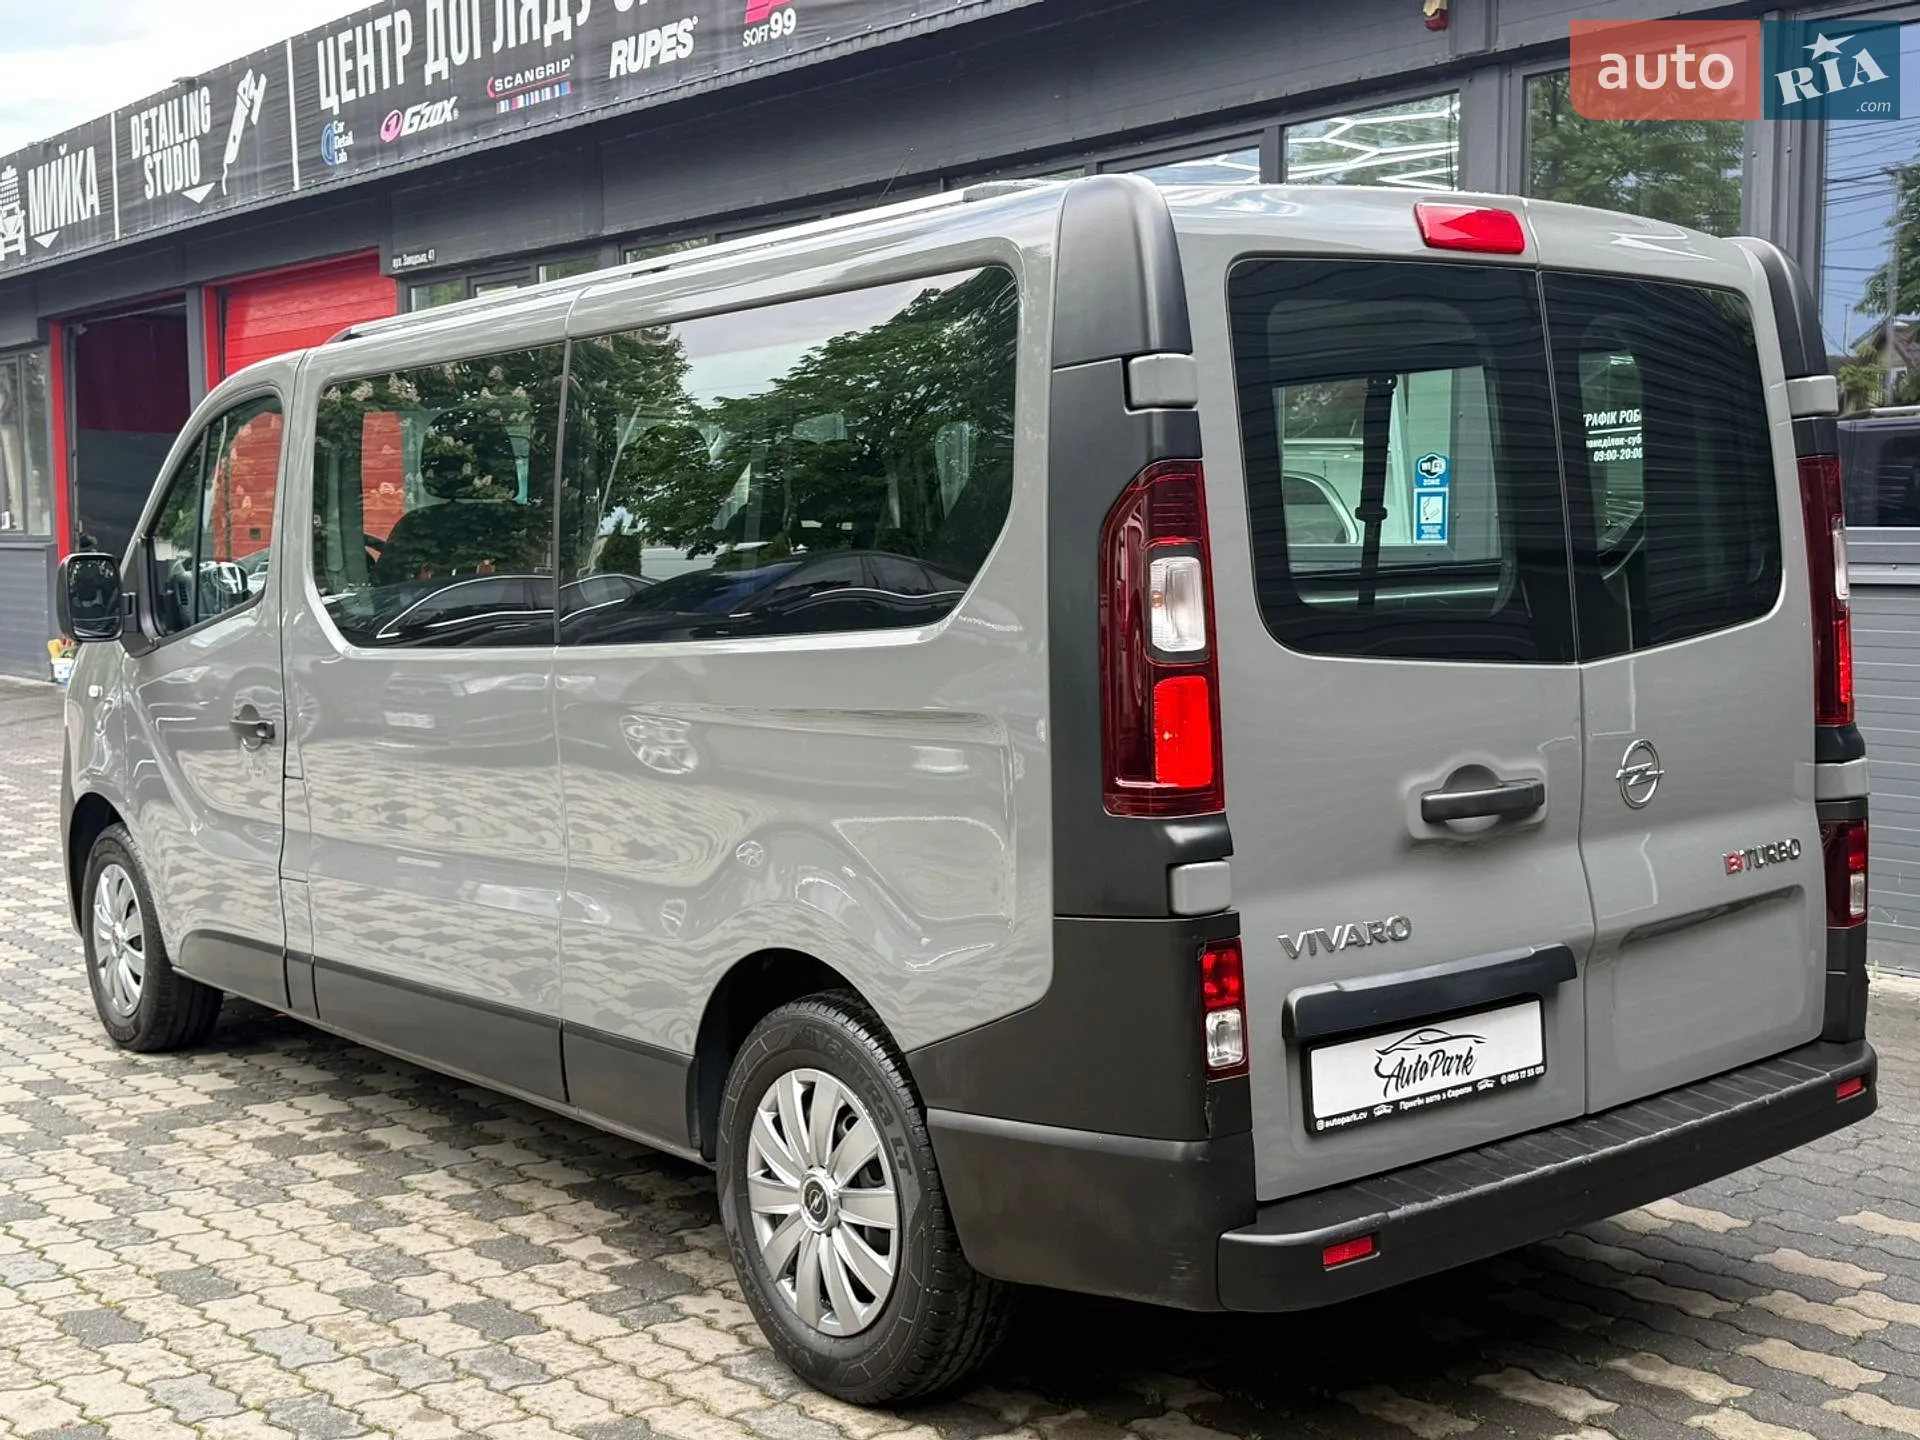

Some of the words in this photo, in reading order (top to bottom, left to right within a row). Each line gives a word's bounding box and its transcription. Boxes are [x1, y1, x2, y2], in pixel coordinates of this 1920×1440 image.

[317, 9, 413, 115] ЦЕНТР
[494, 58, 571, 92] SCANGRIP
[610, 17, 695, 79] RUPES
[130, 86, 211, 159] DETAILING
[27, 143, 101, 236] МИЙКА
[143, 138, 200, 199] STUDIO
[1583, 411, 1617, 427] РАФІК
[1618, 409, 1642, 424] РОБ
[1278, 916, 1412, 960] VIVARO
[1375, 1046, 1477, 1098] AutoPark
